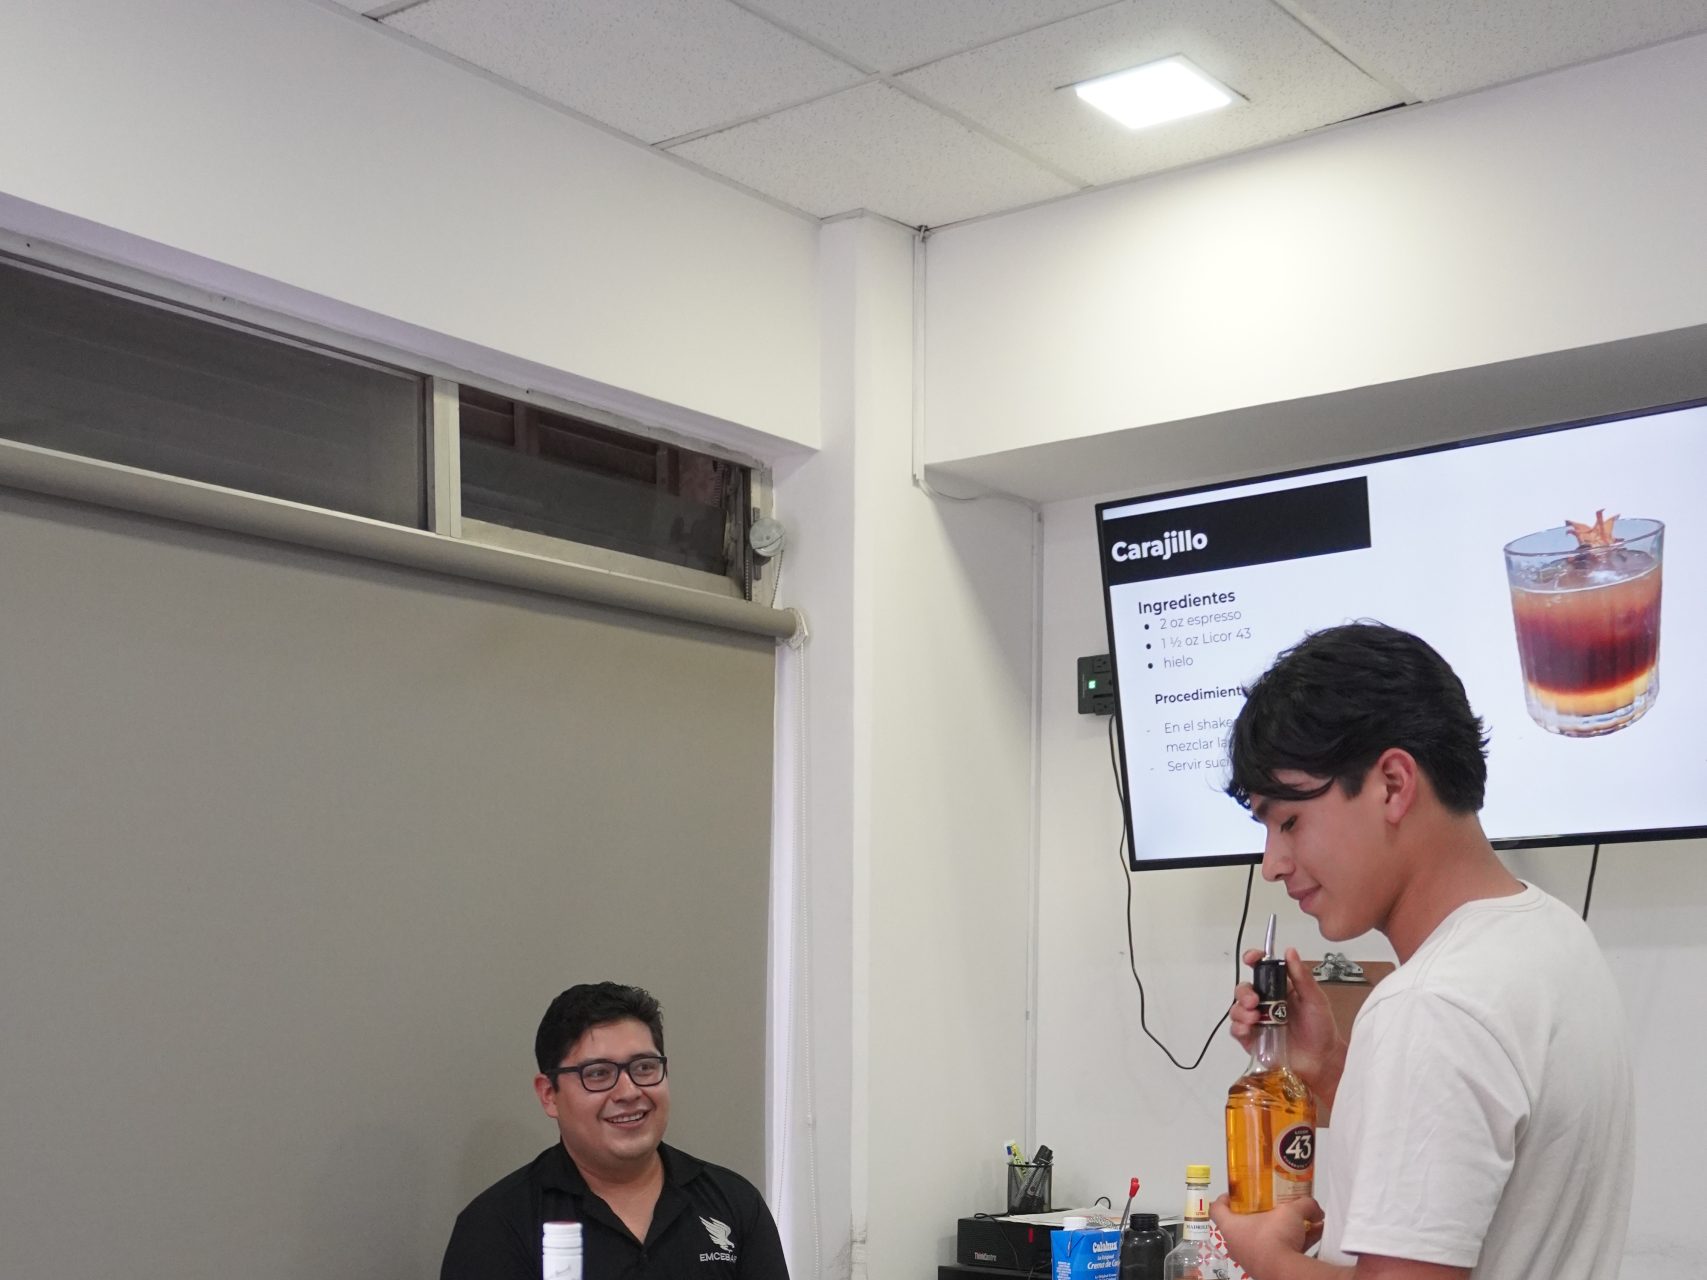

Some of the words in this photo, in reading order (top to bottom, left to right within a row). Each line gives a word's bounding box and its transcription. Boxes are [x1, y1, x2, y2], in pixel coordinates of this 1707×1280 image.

[1111, 529, 1208, 562] Carajillo
[1138, 591, 1236, 615] Ingredientes
[1160, 618, 1167, 630] 2
[1170, 618, 1184, 628] oz
[1187, 611, 1242, 627] espresso
[1161, 638, 1166, 649] 1
[1185, 636, 1199, 646] oz
[1202, 632, 1232, 644] Licor
[1236, 627, 1252, 639] 43
[1163, 655, 1194, 669] hielo
[1155, 686, 1243, 704] Procedimient
[1164, 722, 1180, 734] En
[1183, 720, 1194, 732] el
[1197, 717, 1234, 731] shake
[1166, 738, 1213, 753] mezclar
[1167, 759, 1202, 772] Servir
[1205, 758, 1230, 769] suci
[1274, 1006, 1287, 1018] 43
[1285, 1134, 1312, 1160] 43
